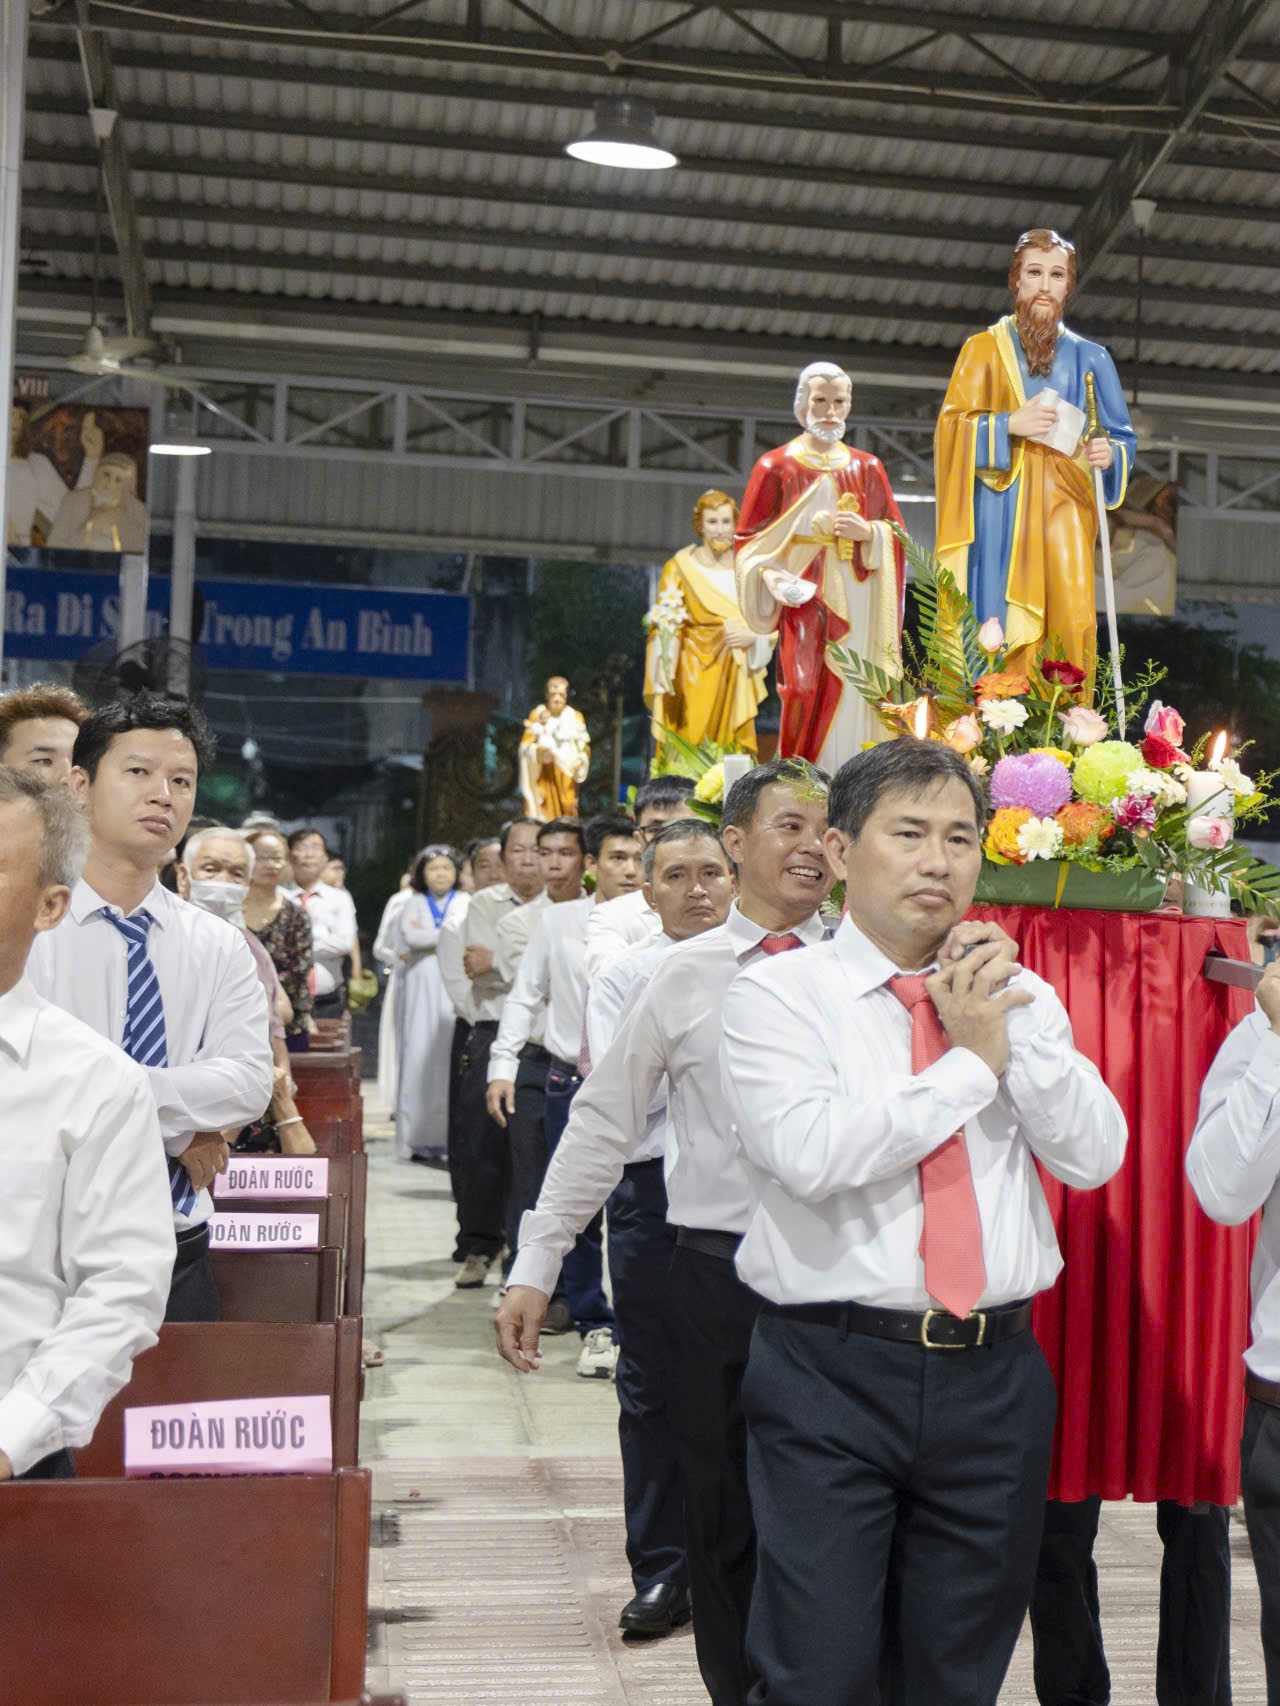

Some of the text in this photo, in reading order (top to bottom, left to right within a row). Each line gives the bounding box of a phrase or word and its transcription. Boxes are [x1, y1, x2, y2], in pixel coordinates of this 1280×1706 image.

[4, 590, 46, 635] Ra
[303, 608, 347, 651] An
[358, 609, 433, 657] Bình
[228, 1166, 313, 1190] ĐOÀN RƯỚC
[257, 1221, 302, 1242] RƯỚC
[150, 1409, 305, 1450] ĐOÀN RƯỚC
